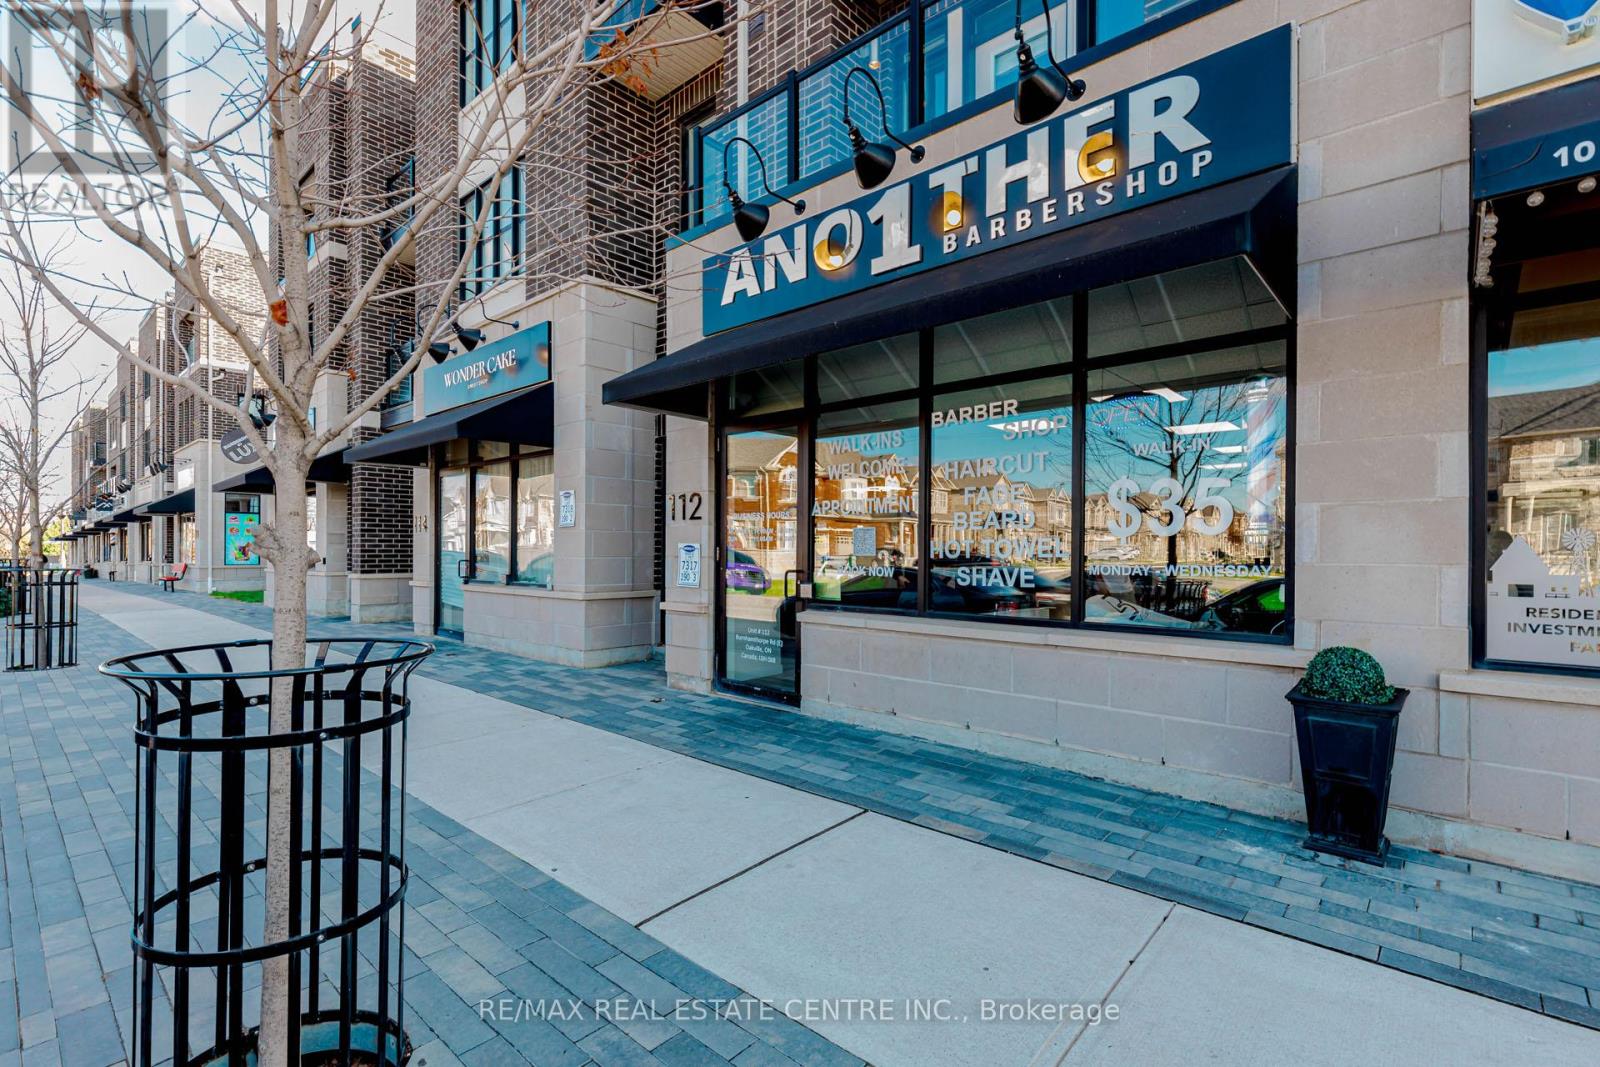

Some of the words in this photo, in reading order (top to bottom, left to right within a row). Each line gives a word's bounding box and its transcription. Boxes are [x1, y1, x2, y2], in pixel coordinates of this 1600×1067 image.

[720, 74, 1213, 307] ANO1THER
[943, 149, 1213, 254] BARBERSHOP
[444, 360, 486, 388] WONDER
[487, 349, 517, 374] CAKE
[931, 399, 1019, 428] BARBER
[1003, 415, 1068, 441] SHOP
[1133, 437, 1211, 457] WALK-IN
[827, 458, 906, 480] WELCOME
[944, 451, 1051, 481] HAIRCUT
[668, 492, 703, 520] 112
[964, 483, 1025, 507] FACE
[953, 510, 1036, 531] BEARD
[1108, 475, 1234, 545] $35
[929, 539, 974, 560] HOT
[980, 535, 1070, 560] TOWEL
[868, 566, 896, 578] NOW
[956, 565, 1036, 588] SHAVE
[1088, 564, 1150, 577] MONDAY
[1164, 564, 1273, 577] WEDNESDAY
